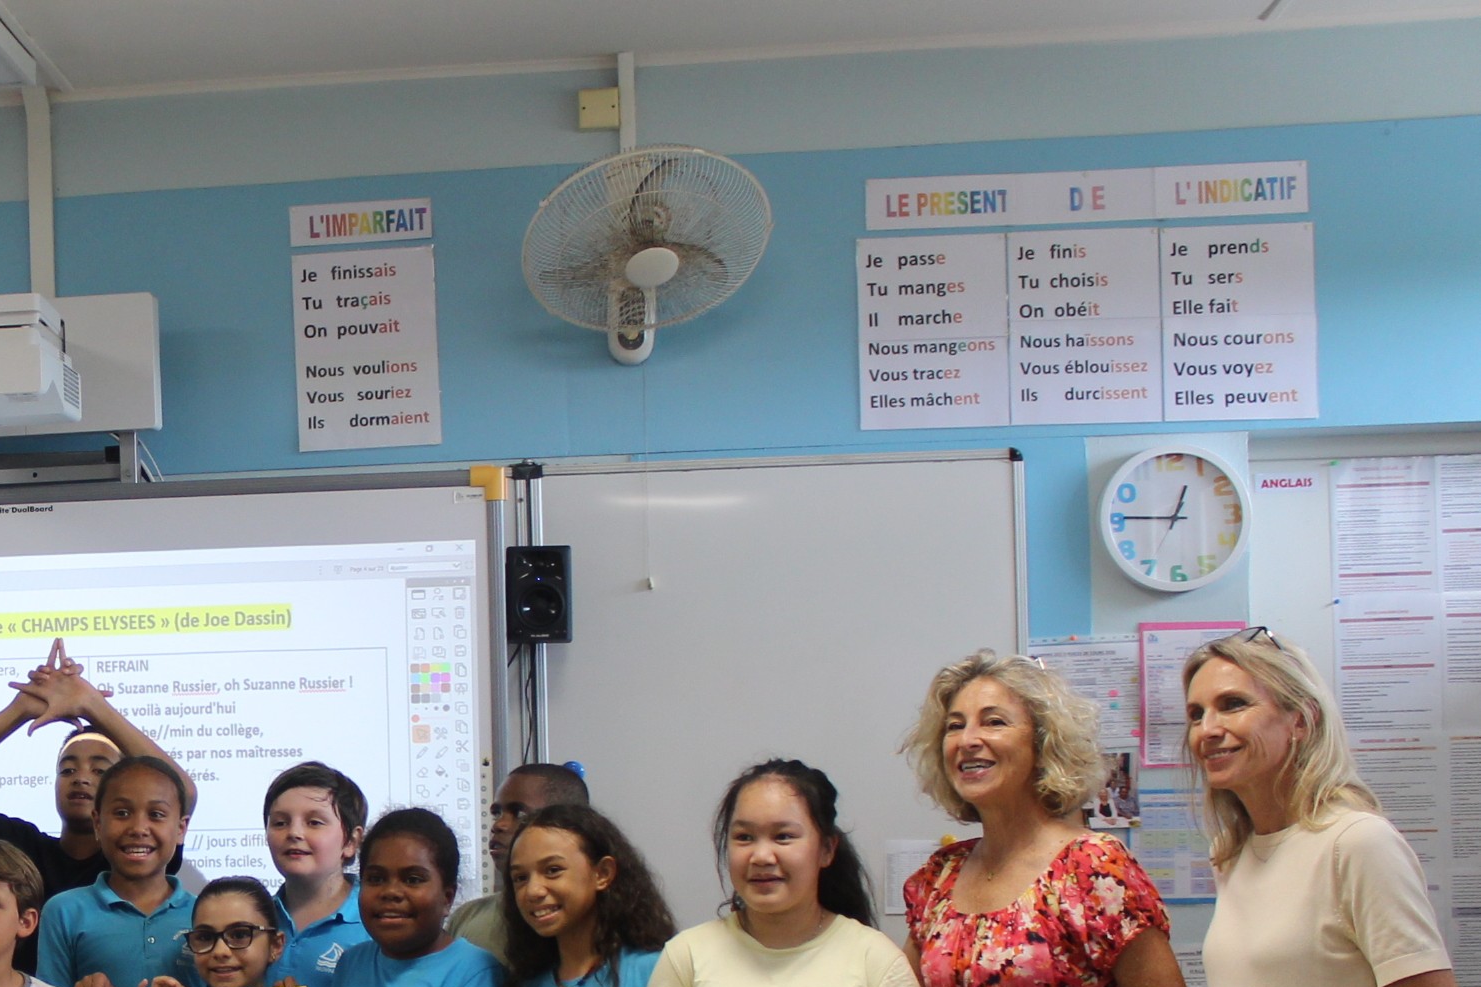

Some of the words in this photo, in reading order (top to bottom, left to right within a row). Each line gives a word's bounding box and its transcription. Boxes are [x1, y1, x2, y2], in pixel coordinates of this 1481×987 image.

[886, 193, 910, 218] LE
[916, 189, 1007, 217] PRESENT
[309, 207, 427, 239] L'IMPARFAIT
[1017, 247, 1035, 261] Je
[1049, 243, 1087, 259] finis
[1170, 242, 1188, 257] Je
[1208, 238, 1269, 258] prends
[866, 254, 883, 269] Je
[898, 252, 946, 269] passe
[300, 269, 318, 283] Je
[331, 263, 397, 281] finissais
[1018, 275, 1040, 289] Tu
[1050, 272, 1109, 288] choisis
[1171, 271, 1192, 286] Tu
[1207, 270, 1243, 284] sers
[867, 283, 888, 297] Tu
[898, 279, 965, 298] manges
[302, 297, 323, 310] Tu
[336, 292, 391, 310] traçais
[1019, 304, 1044, 319] On
[1054, 301, 1100, 318] obéit
[1172, 299, 1204, 315] Elle
[1209, 298, 1239, 314] fait
[898, 309, 963, 327] marche
[304, 324, 328, 338] On
[337, 319, 400, 339] pouvait
[869, 342, 909, 356] Nous
[913, 339, 996, 356] mangeons
[1020, 334, 1061, 349] Nous
[1066, 331, 1134, 348] haïssons
[1173, 332, 1218, 347] Nous
[1223, 330, 1294, 346] courons
[306, 365, 345, 379] Nous
[353, 360, 417, 376] voulions
[869, 368, 908, 382] Vous
[913, 366, 961, 380] tracez
[1020, 362, 1060, 376] Vous
[1064, 360, 1148, 374] éblouissez
[1173, 362, 1217, 376] Vous
[1222, 362, 1273, 377] voyez
[306, 391, 345, 404] Vous
[357, 386, 412, 401] souriez
[870, 394, 905, 409] Elles
[911, 391, 980, 408] mâchent
[1021, 388, 1038, 402] Ils
[1064, 387, 1148, 402] durcissent
[1174, 391, 1215, 406] Elles
[1224, 389, 1298, 408] peuvent
[307, 416, 325, 430] Ils
[349, 411, 430, 429] dormaient
[1213, 475, 1234, 496] 2
[1260, 477, 1313, 489] ANGLAIS
[1223, 503, 1242, 525] 3
[1118, 540, 1137, 560] 8
[1140, 559, 1156, 576] 7
[22, 616, 89, 634] CHAMPS
[93, 615, 156, 631] ELYSEES
[174, 612, 199, 632] (de
[203, 611, 230, 628] Joe
[234, 608, 292, 629] Dassin)
[96, 659, 149, 673] REFRAIN
[117, 682, 169, 695] Suzanne
[172, 679, 221, 694] Russier,
[224, 678, 241, 692] oh
[243, 677, 296, 692] Suzanne
[299, 676, 345, 690] Russier
[131, 702, 161, 717] voilà
[164, 702, 236, 719] aujourd'hui
[196, 725, 213, 737] du
[215, 723, 264, 740] collège,
[187, 748, 207, 762] par
[211, 748, 232, 759] nos
[236, 744, 302, 759] maîtresses
[0, 774, 52, 790] partager.
[206, 836, 237, 850] jours
[225, 855, 267, 869] faciles,
